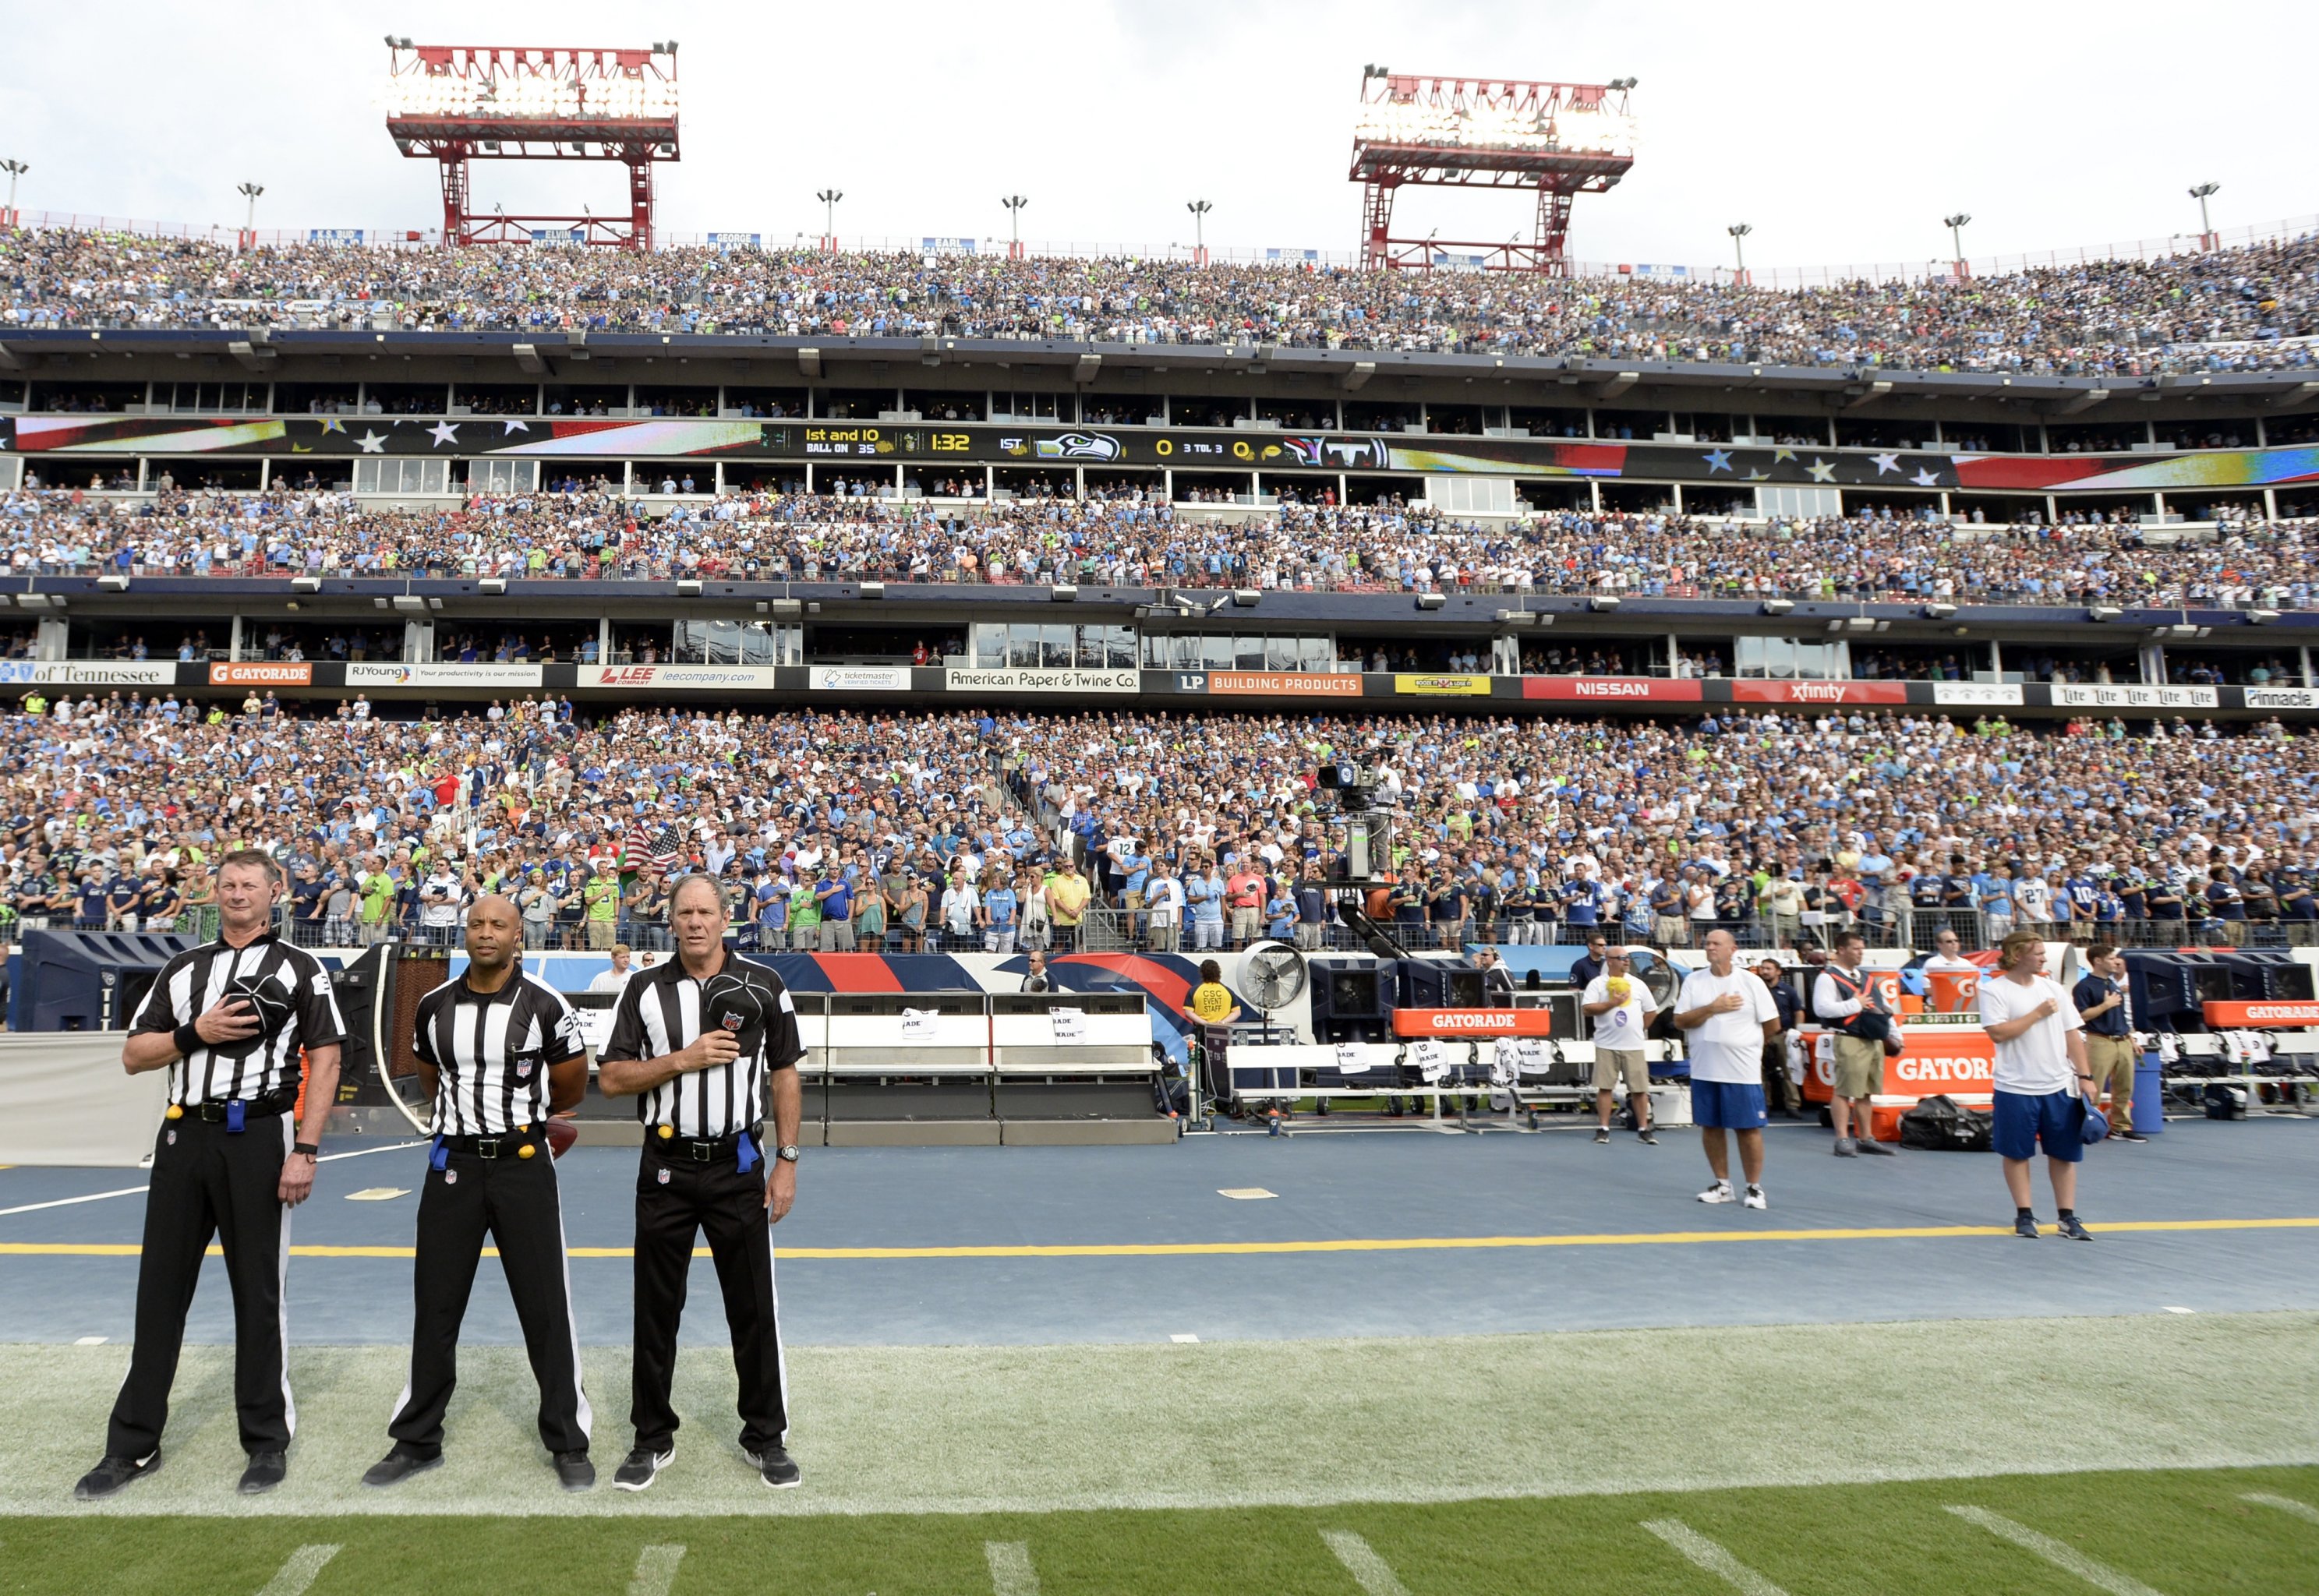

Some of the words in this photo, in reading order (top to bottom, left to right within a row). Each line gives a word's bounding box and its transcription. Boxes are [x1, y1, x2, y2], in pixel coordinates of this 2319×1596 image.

[717, 234, 751, 242] GEORGE
[935, 238, 962, 247] EARL
[1280, 249, 1305, 258] EDDIE
[829, 429, 857, 441] and
[807, 443, 832, 453] BALL
[833, 443, 849, 454] ON
[858, 443, 875, 454] 35
[932, 434, 970, 451] 1:32
[1183, 444, 1192, 453] 3
[1194, 444, 1213, 453] TOL
[1215, 444, 1223, 454] 3
[35, 666, 55, 682] of
[62, 666, 160, 683] Tennessee
[213, 666, 228, 682] G
[232, 666, 309, 680] GATORADE
[352, 666, 402, 678] RJYoung
[438, 669, 483, 679] productivity
[620, 668, 656, 680] LEE
[663, 671, 755, 683] leecompany.com
[844, 672, 894, 680] ticketmaster
[951, 671, 1013, 686] American
[1020, 673, 1059, 688] Paper
[1062, 673, 1072, 686] &
[1074, 673, 1112, 687] Twine
[1181, 676, 1204, 690] LP
[1214, 677, 1280, 690] BUILDING
[1285, 679, 1356, 690] PRODUCTS
[1575, 682, 1649, 696] NISSAN
[1791, 682, 1846, 702] xfinity
[2063, 689, 2087, 704] Lite
[2095, 689, 2118, 704] Lite
[2126, 690, 2149, 705] Lite
[2158, 690, 2181, 705] Lite
[2190, 690, 2213, 706] Lite
[1119, 843, 1130, 856] 12
[870, 854, 887, 870] 12
[2025, 889, 2044, 904] 27
[2074, 887, 2093, 903] 10
[1879, 979, 1897, 998] G
[1958, 979, 1974, 998] G
[725, 1019, 740, 1029] NFL
[1432, 1015, 1515, 1028] GATORADE
[518, 1066, 532, 1075] NFL
[1896, 1058, 1994, 1081] GATOR
